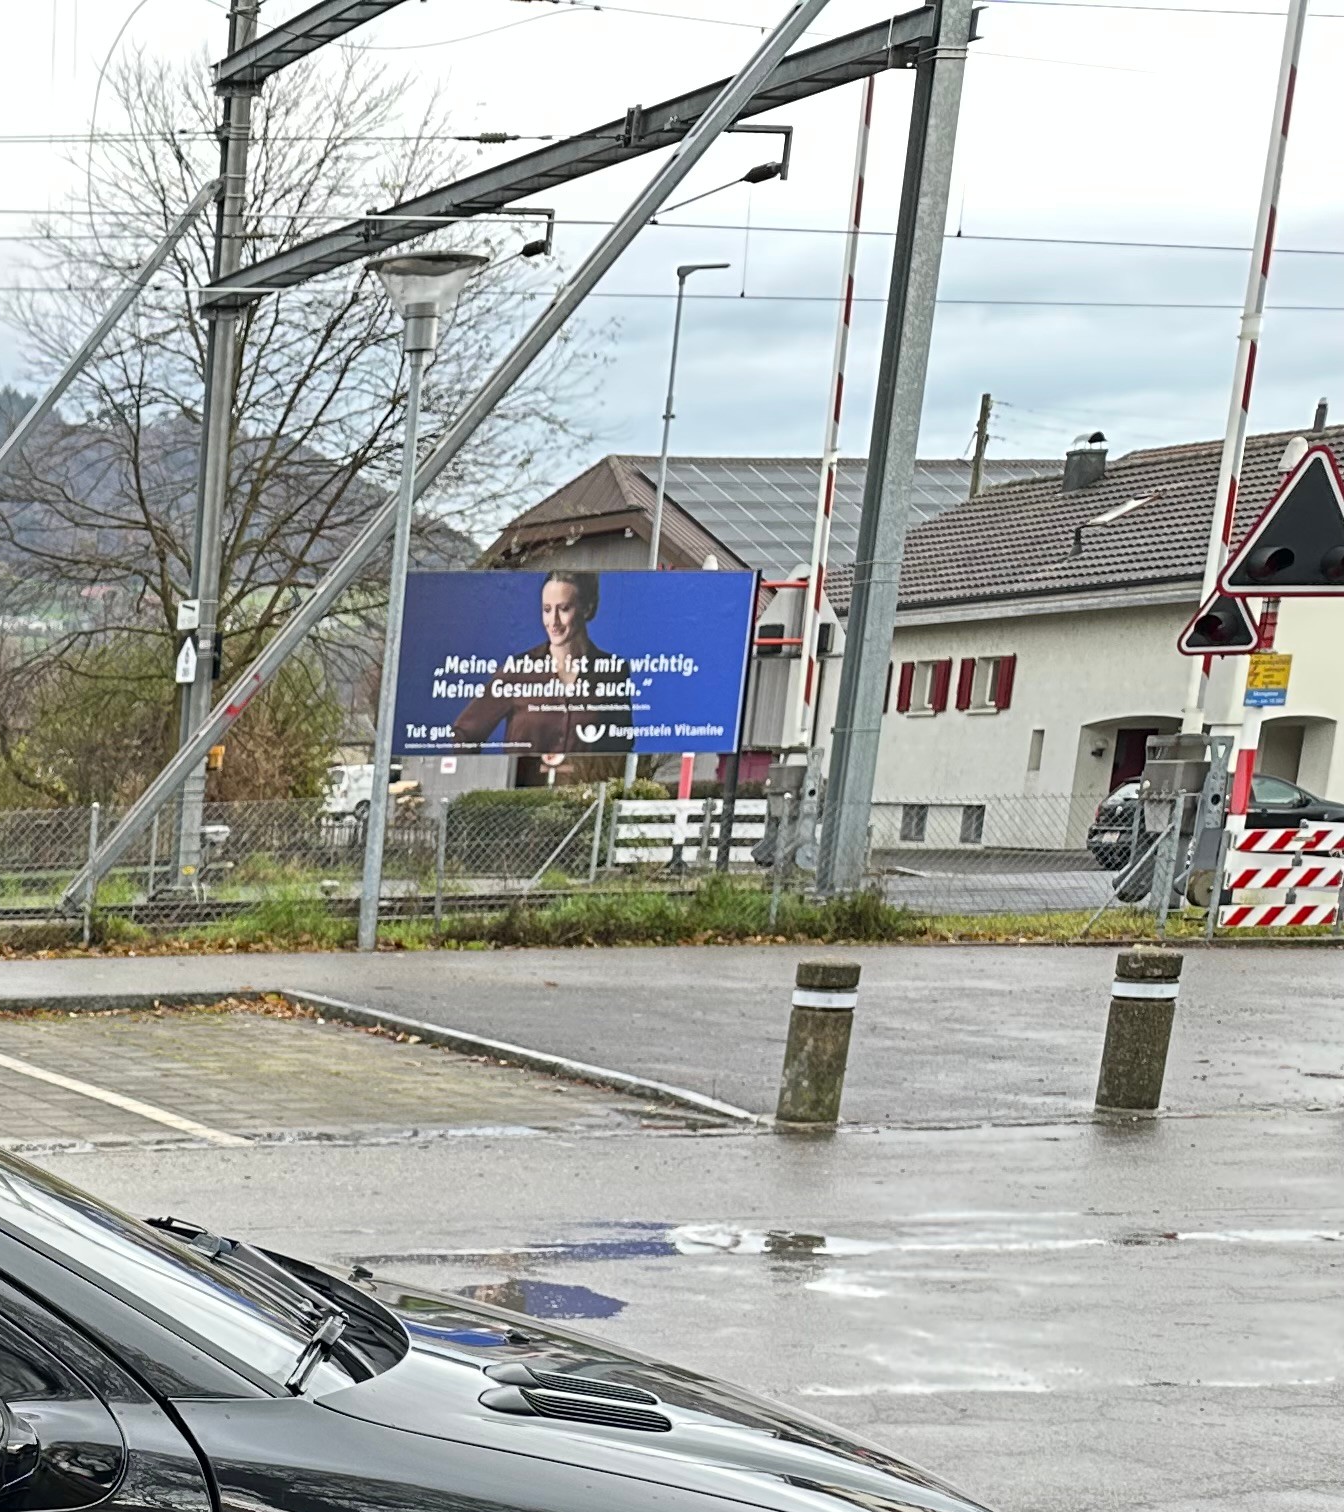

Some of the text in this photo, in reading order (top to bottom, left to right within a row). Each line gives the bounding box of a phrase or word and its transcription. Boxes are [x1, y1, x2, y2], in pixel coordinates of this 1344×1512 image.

[503, 654, 559, 674] Arbeit
[564, 654, 589, 673] ist
[594, 654, 626, 673] mir
[630, 653, 700, 677] wichtig.
[432, 679, 485, 698] Meine
[491, 678, 590, 698] Gesundheit
[405, 723, 456, 741] Tut gut.
[608, 723, 724, 740] Burgerstein Vitamine
